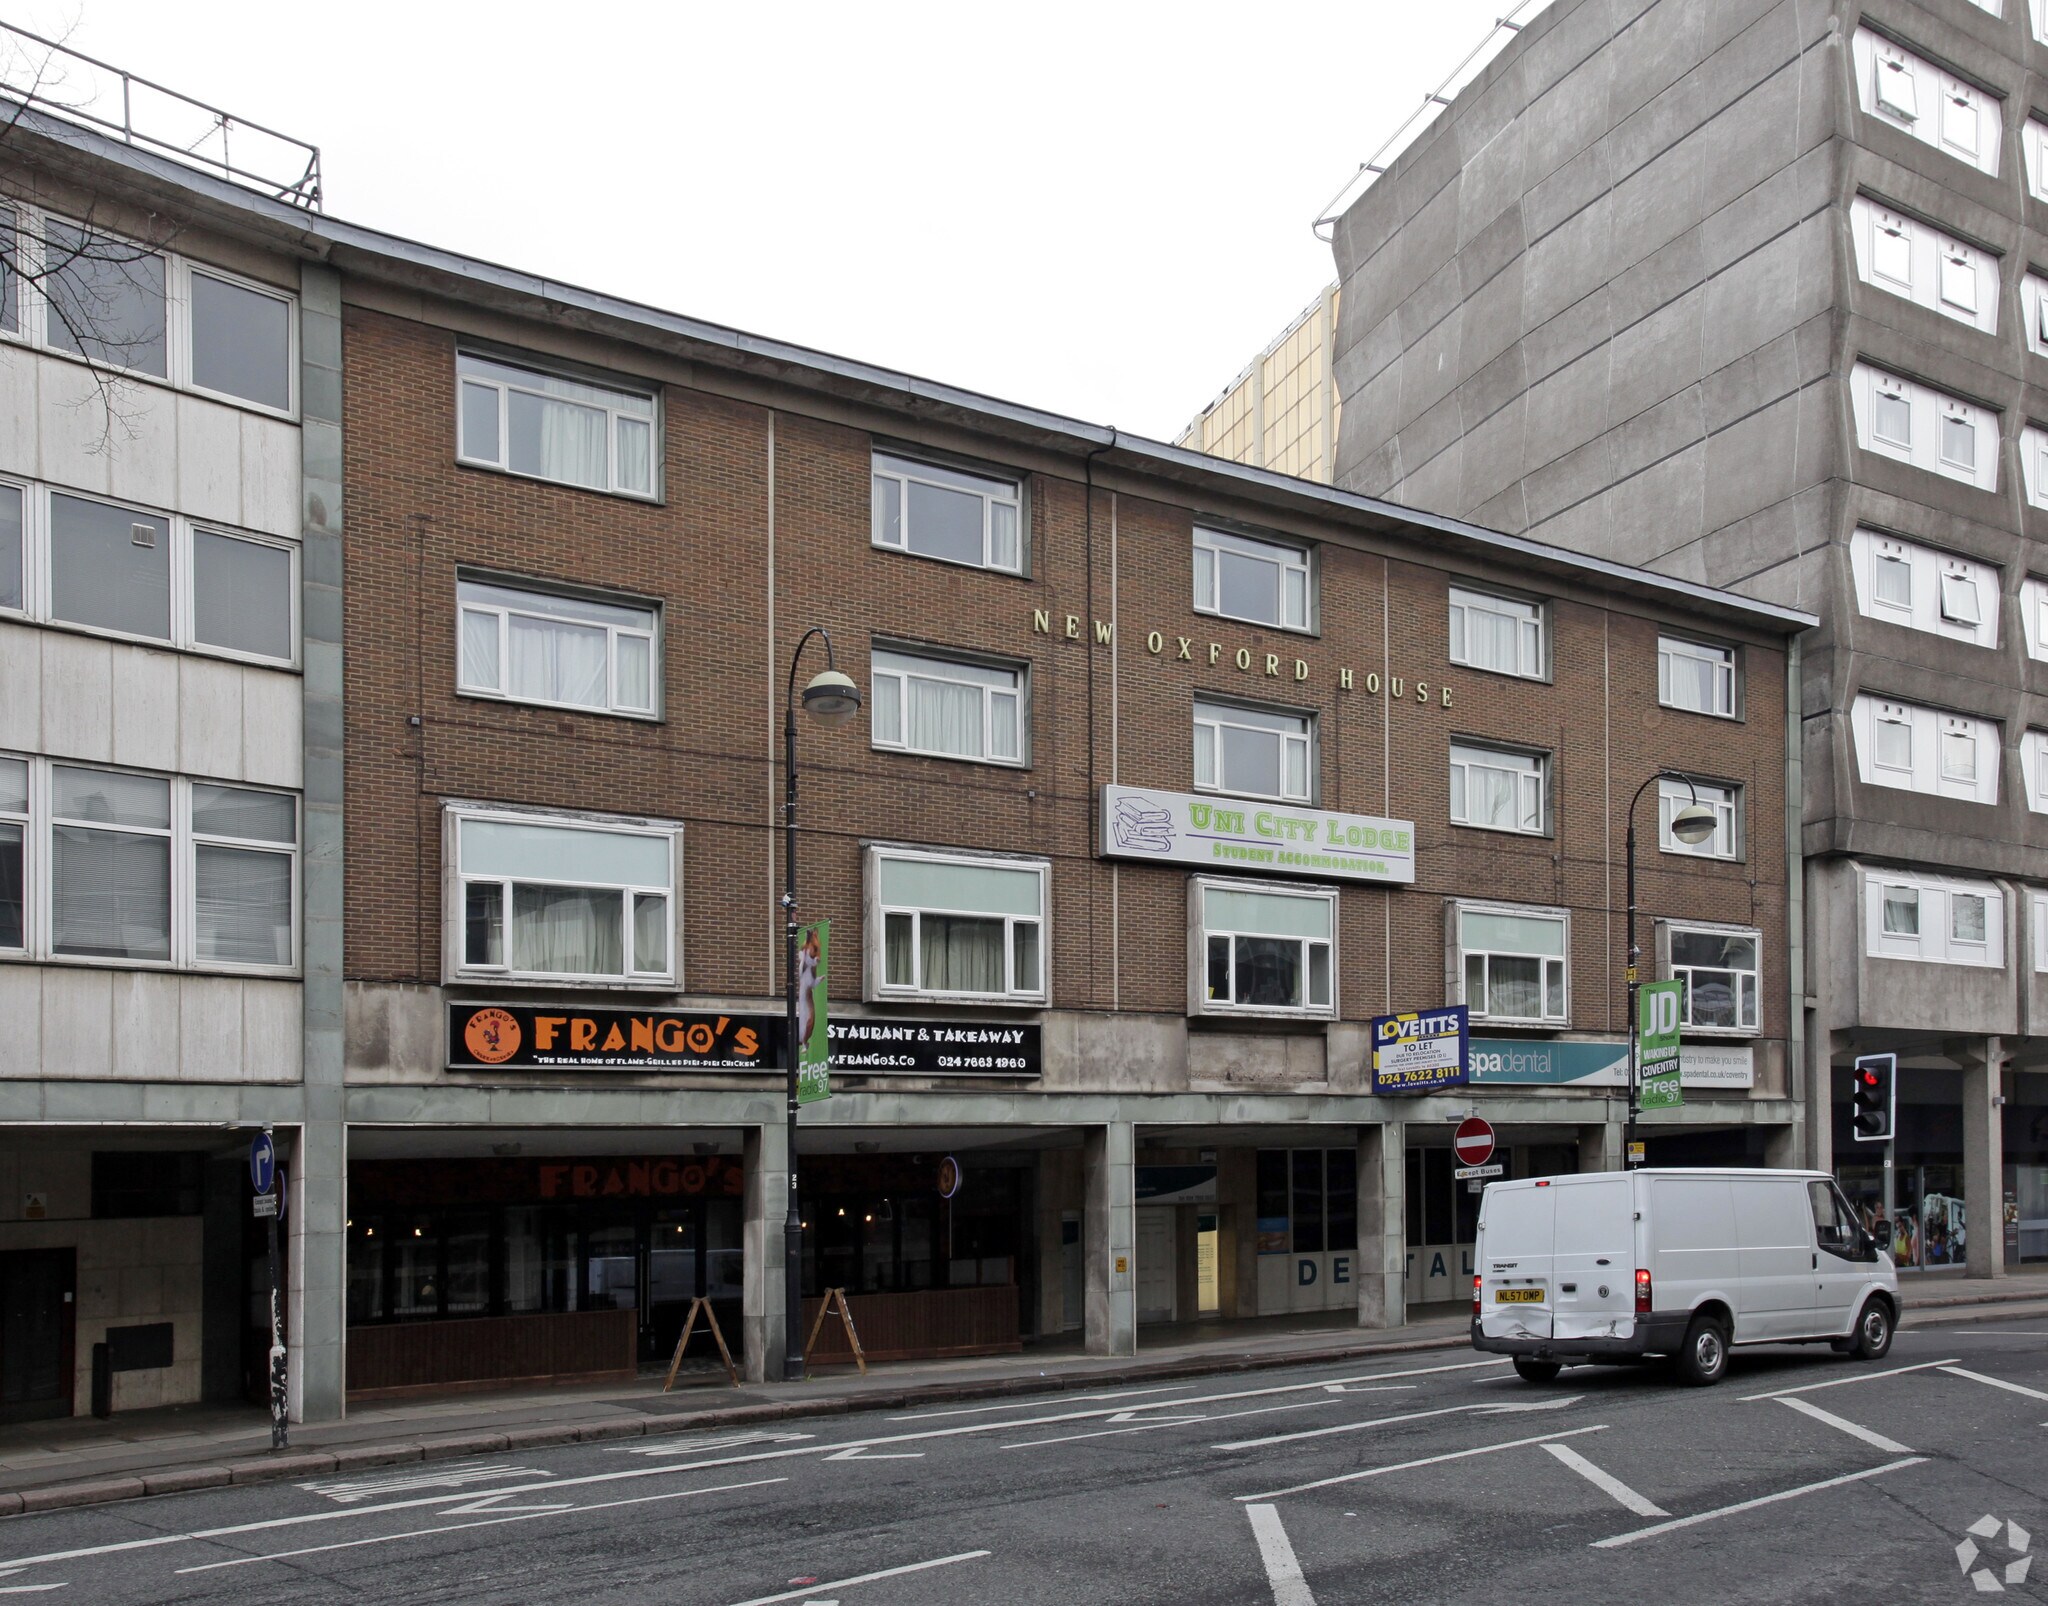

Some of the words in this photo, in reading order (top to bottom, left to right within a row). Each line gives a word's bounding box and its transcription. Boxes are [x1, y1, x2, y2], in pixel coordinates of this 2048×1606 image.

[1033, 609, 1113, 645] NEW
[1148, 631, 1308, 681] OXFORD
[1340, 668, 1453, 708] HOUSE
[1189, 803, 1245, 834] UNI
[1254, 811, 1318, 842] CITY
[1327, 819, 1409, 851] LODGE
[1213, 842, 1274, 863] STUDENT
[469, 1010, 517, 1031] FRANGO'S
[1645, 990, 1677, 1037] JD
[534, 1016, 760, 1056] FRANGO'S
[917, 1028, 930, 1041] &
[933, 1029, 1024, 1045] TAKEAWAY
[1378, 1014, 1459, 1040] LOVEITTS
[1403, 1043, 1416, 1052] TO
[1418, 1042, 1433, 1051] LET
[1643, 1047, 1668, 1060] WAKING
[1668, 1045, 1677, 1056] UP
[937, 1055, 962, 1067] 024
[995, 1057, 1026, 1067] 1960
[1642, 1058, 1678, 1077] COVENTRY
[1705, 1055, 1721, 1065] make
[1722, 1057, 1732, 1066] you
[1733, 1056, 1748, 1065] smile
[800, 1061, 828, 1083] Free
[1379, 1074, 1400, 1085] 024
[1404, 1070, 1432, 1082] 7622
[1436, 1067, 1460, 1079] 8111
[1392, 1078, 1446, 1088] www.loveitts.co.uk
[1642, 1080, 1679, 1095] Free
[539, 1158, 744, 1197] FRANGO'S
[1500, 1291, 1521, 1301] NL57
